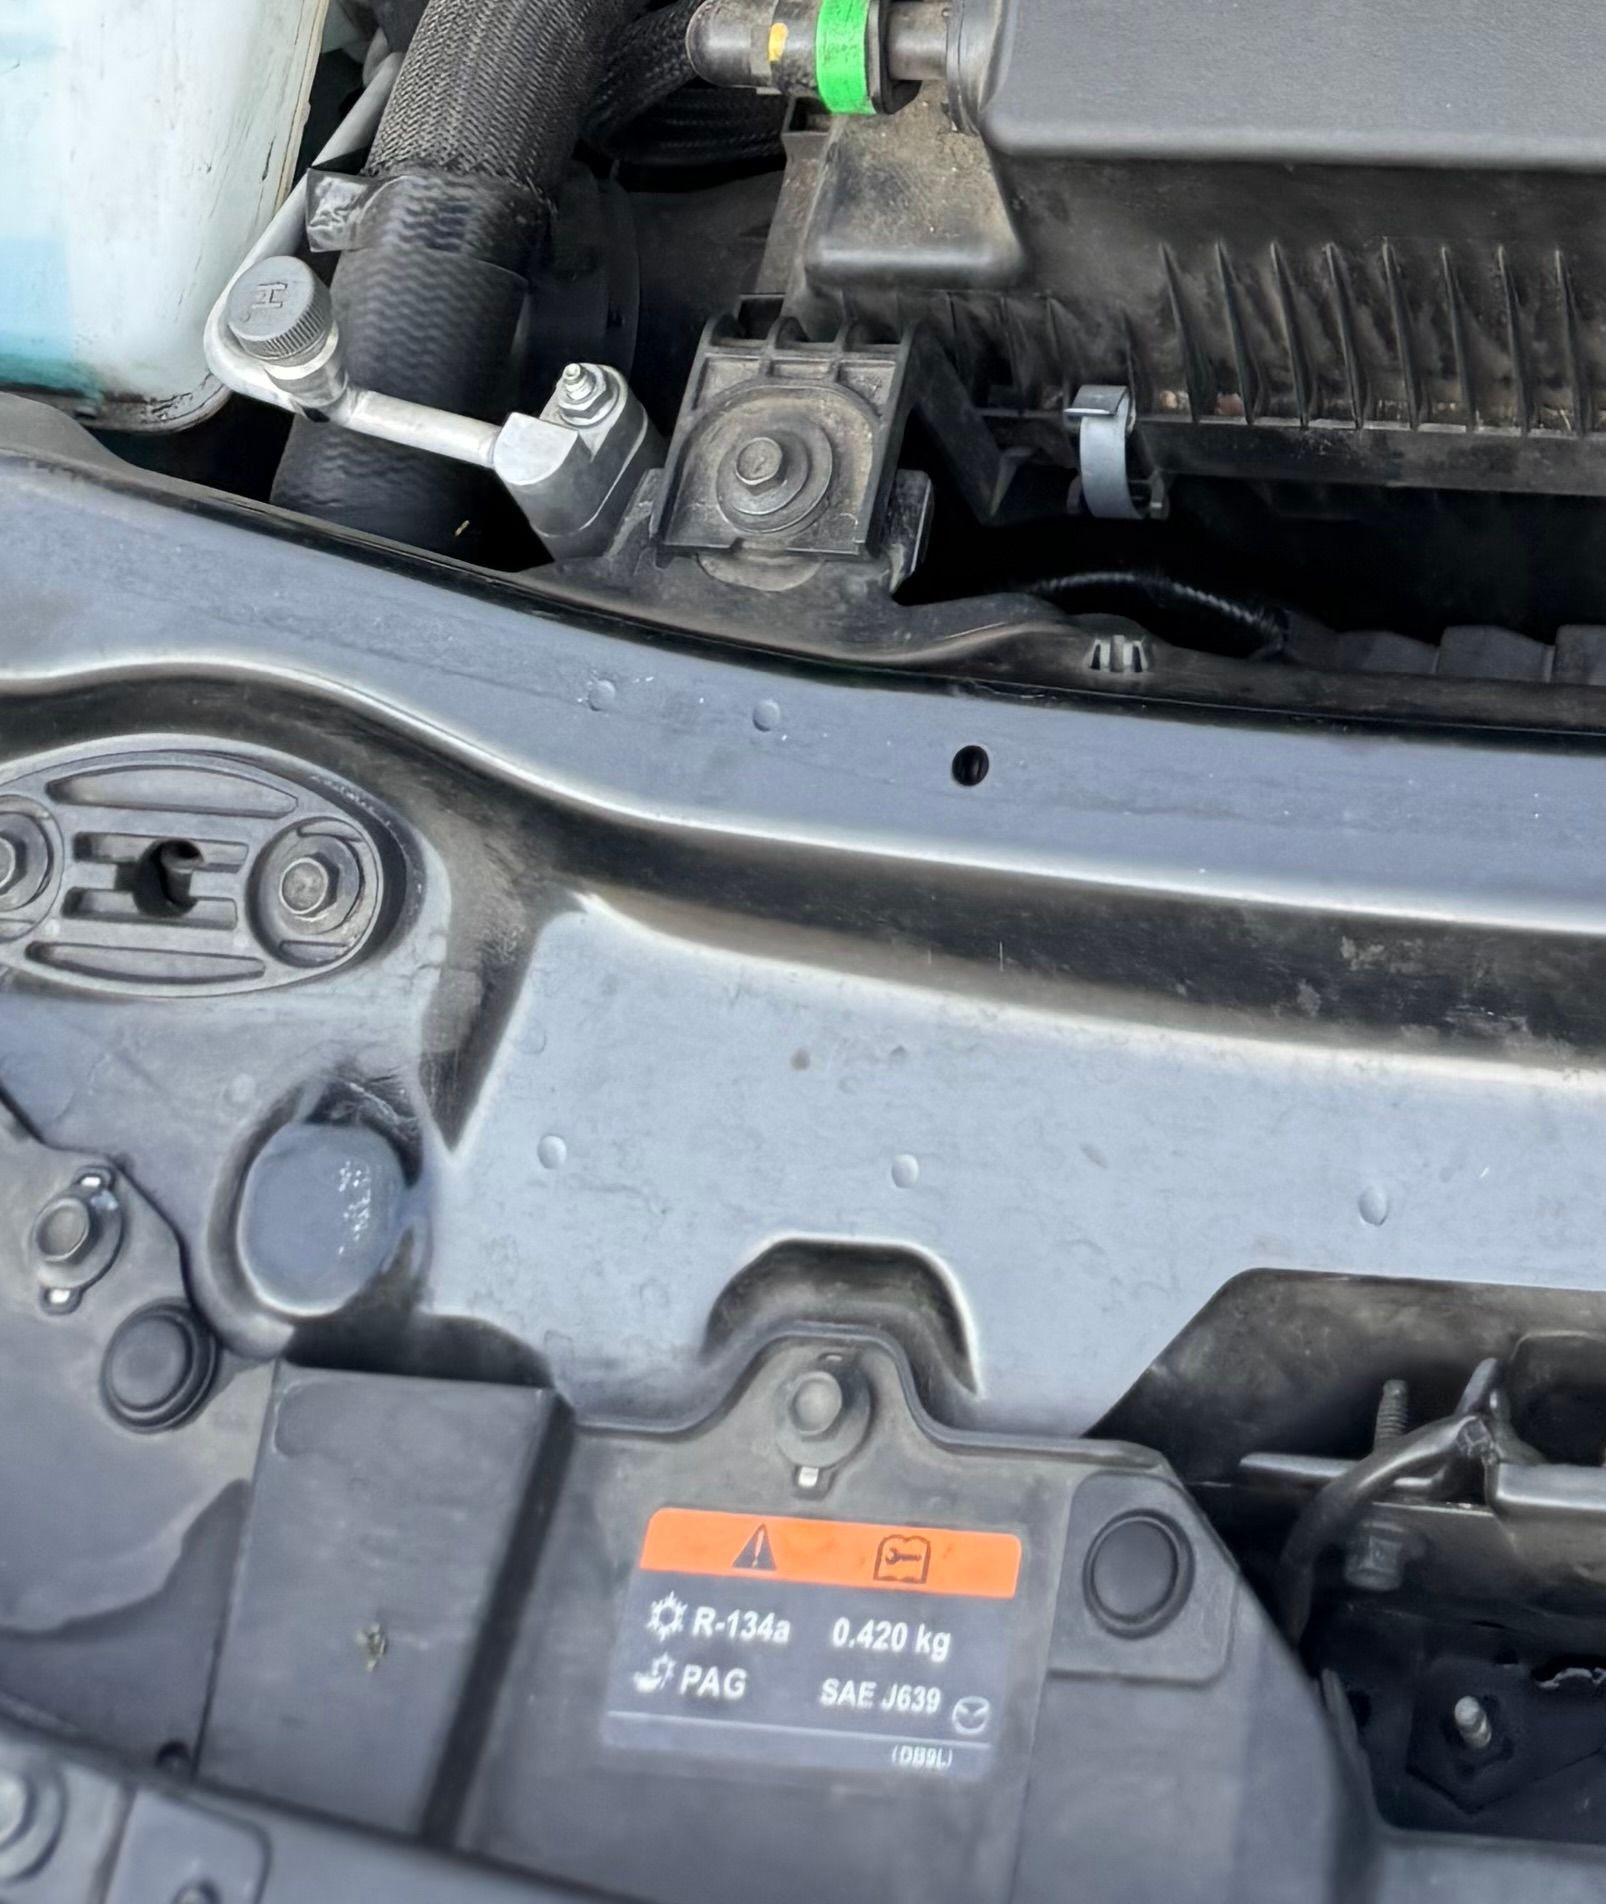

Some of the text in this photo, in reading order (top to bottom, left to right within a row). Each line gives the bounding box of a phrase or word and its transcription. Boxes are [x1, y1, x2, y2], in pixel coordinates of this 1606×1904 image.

[252, 281, 289, 310] H
[691, 1605, 952, 1664] R-134a 0.420 kg
[679, 1663, 942, 1715] PAG SAE J639
